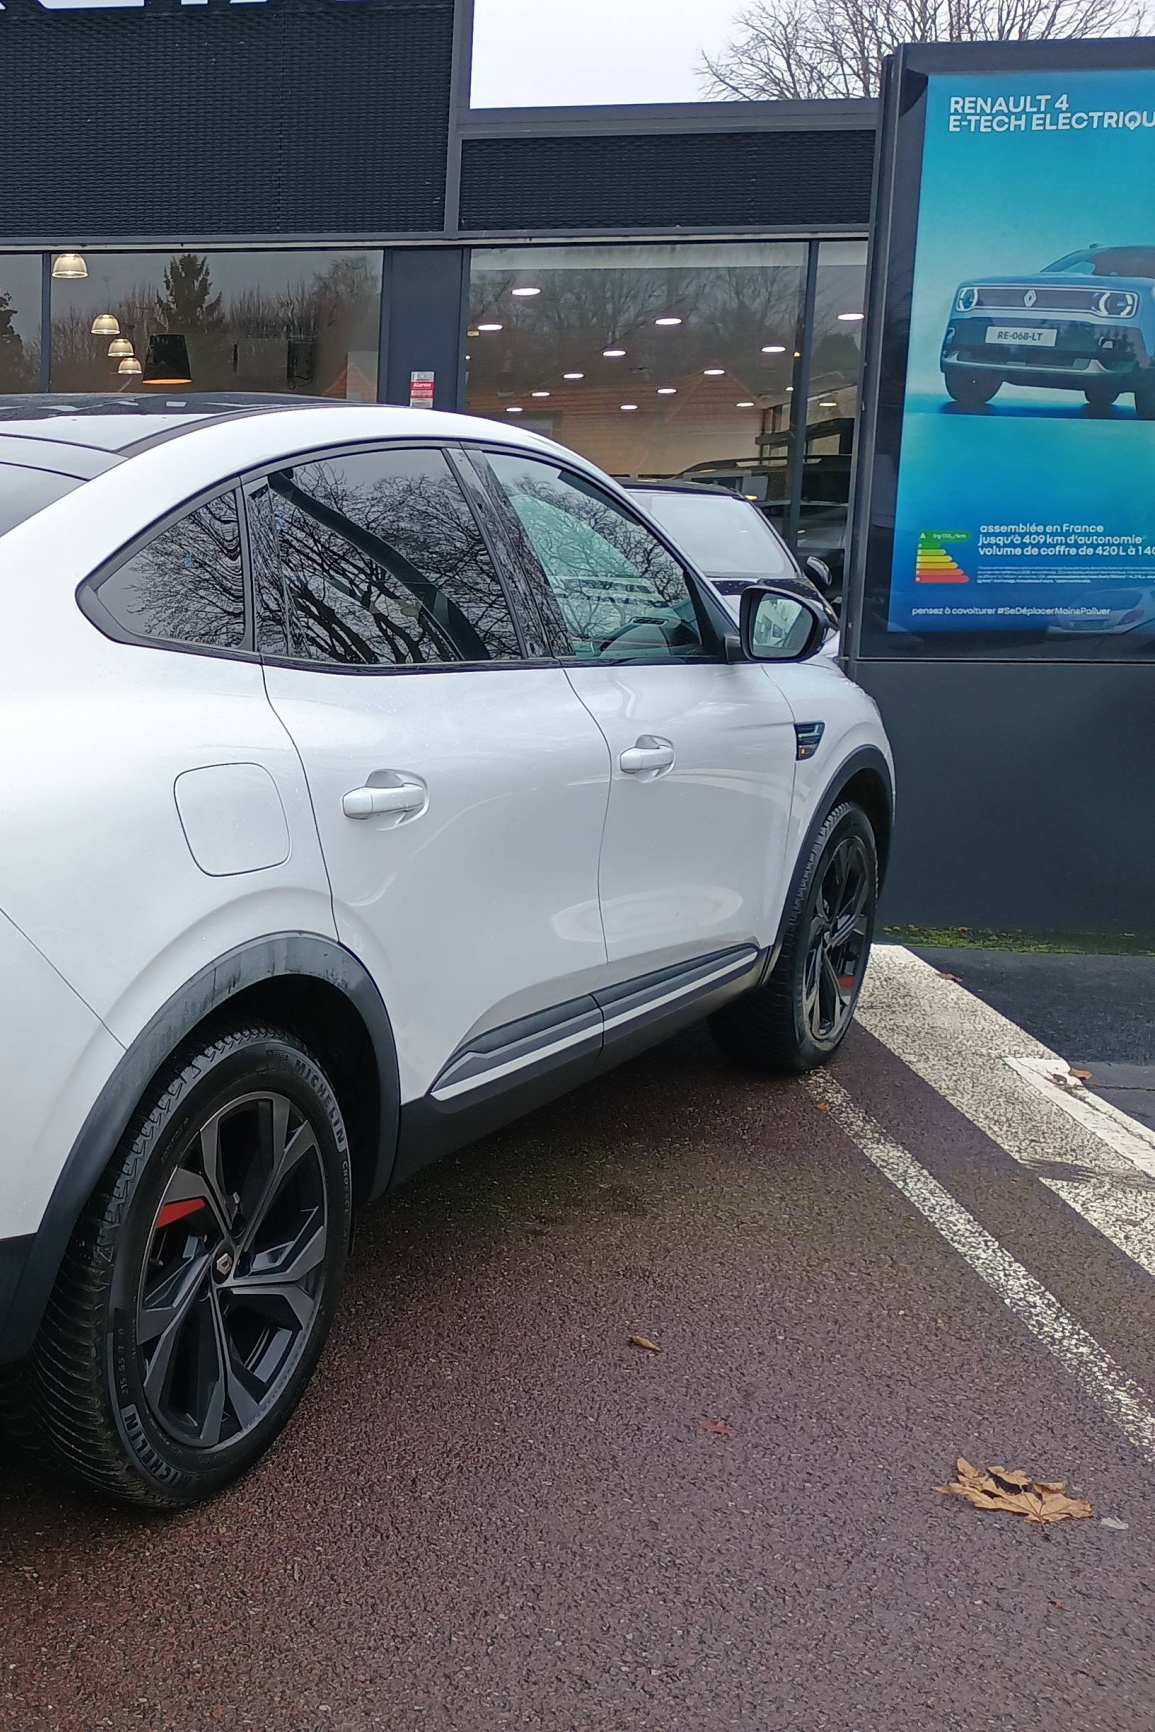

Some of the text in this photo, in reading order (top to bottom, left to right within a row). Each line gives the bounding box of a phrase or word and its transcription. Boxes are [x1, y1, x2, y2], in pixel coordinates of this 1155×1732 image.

[949, 93, 1070, 114] RENAULT 4
[948, 114, 1027, 132] E-TECH
[997, 330, 1044, 341] RE-068-LT
[979, 522, 1105, 533] assemblée en France
[1022, 534, 1046, 545] 409
[1046, 534, 1065, 544] km
[978, 545, 1023, 556] volume
[1023, 545, 1039, 555] de
[1040, 545, 1077, 556] coffre
[1078, 545, 1094, 555] de
[1095, 546, 1118, 556] 420
[1119, 546, 1126, 555] L
[1127, 545, 1136, 555] à
[911, 607, 944, 617] pensez
[951, 606, 996, 616] covoiturer
[295, 1057, 346, 1145] MICHELIN
[123, 1411, 193, 1488] MICHELIN
